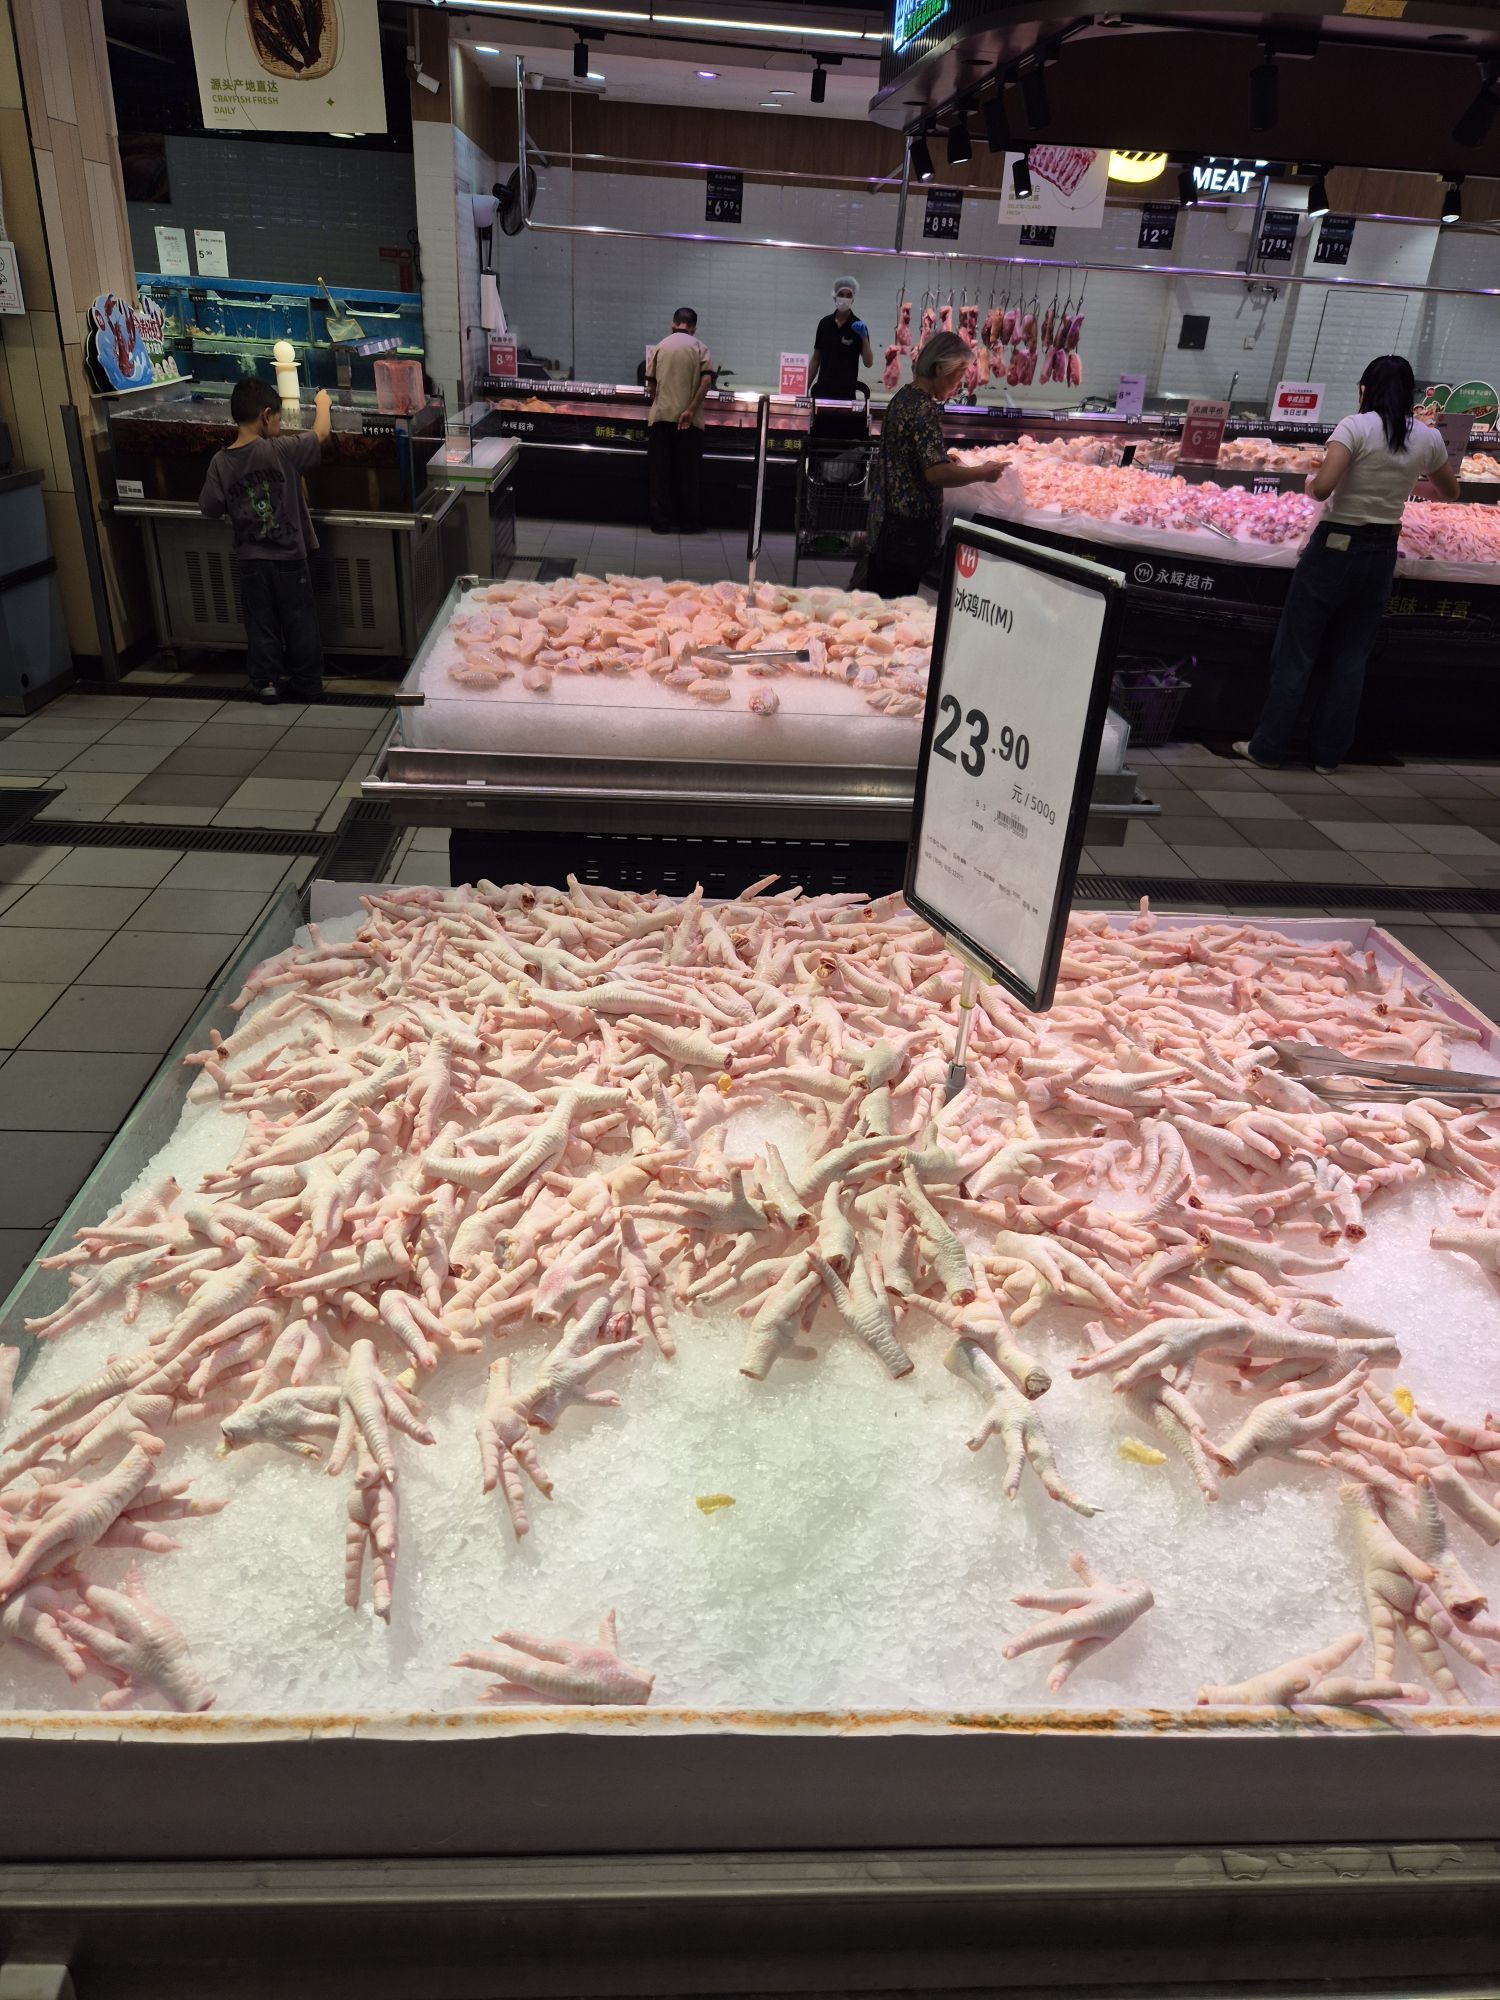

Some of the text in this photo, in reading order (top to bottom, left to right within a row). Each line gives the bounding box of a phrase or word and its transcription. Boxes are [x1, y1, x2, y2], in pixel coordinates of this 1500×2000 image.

[210, 78, 279, 92] 源头产地直达
[212, 94, 279, 105] CRAYFISH FRESH
[213, 106, 236, 115] DAILY
[1192, 166, 1256, 193] MEAT
[501, 421, 535, 431] 永辉超市
[1154, 568, 1215, 591] 永辉超市
[954, 587, 1014, 634] 冰鸡爪(M)
[1385, 596, 1472, 619] 美味 丰富
